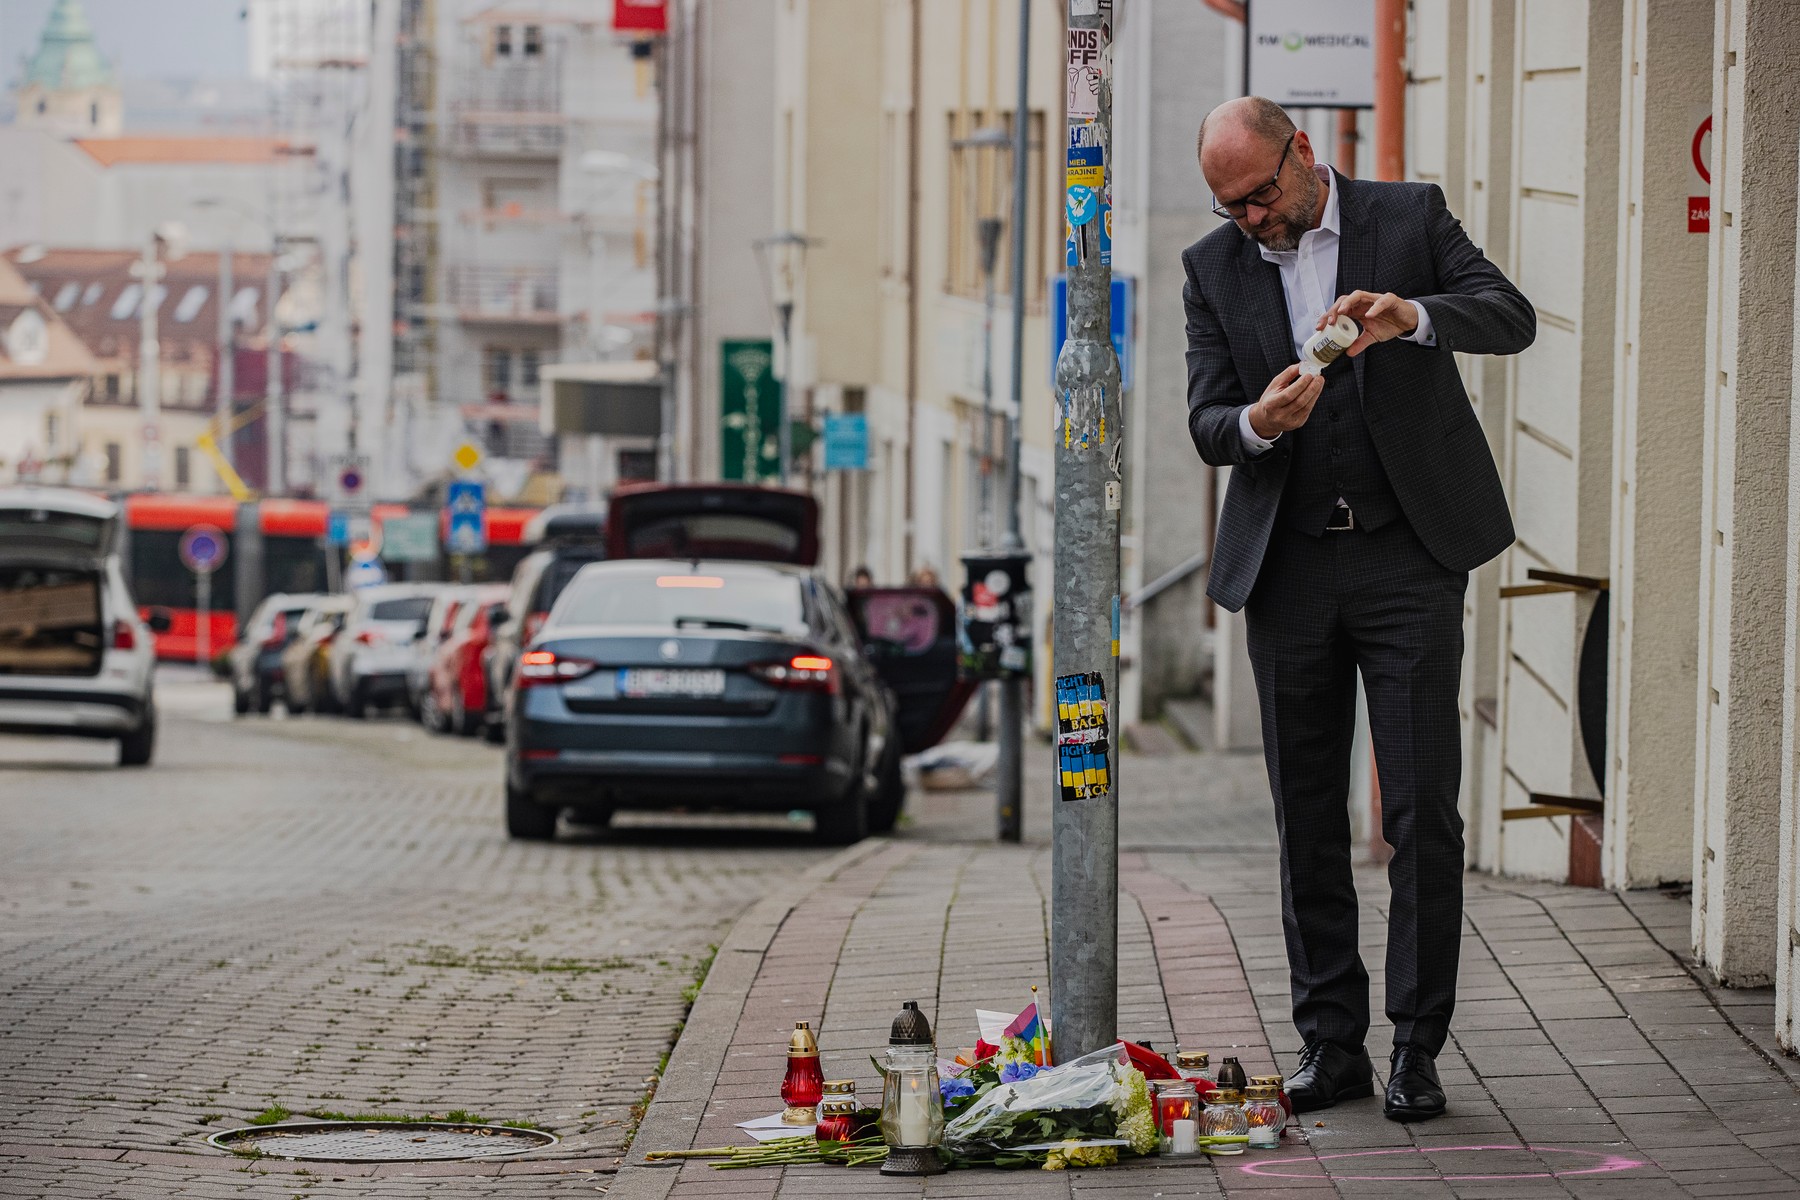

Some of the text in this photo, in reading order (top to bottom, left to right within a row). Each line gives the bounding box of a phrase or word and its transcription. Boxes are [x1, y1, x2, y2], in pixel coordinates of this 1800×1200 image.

[1069, 158, 1087, 166] MIER
[1071, 715, 1104, 730] BACK
[1061, 744, 1090, 756] FIGHT
[1075, 783, 1108, 798] BACK
